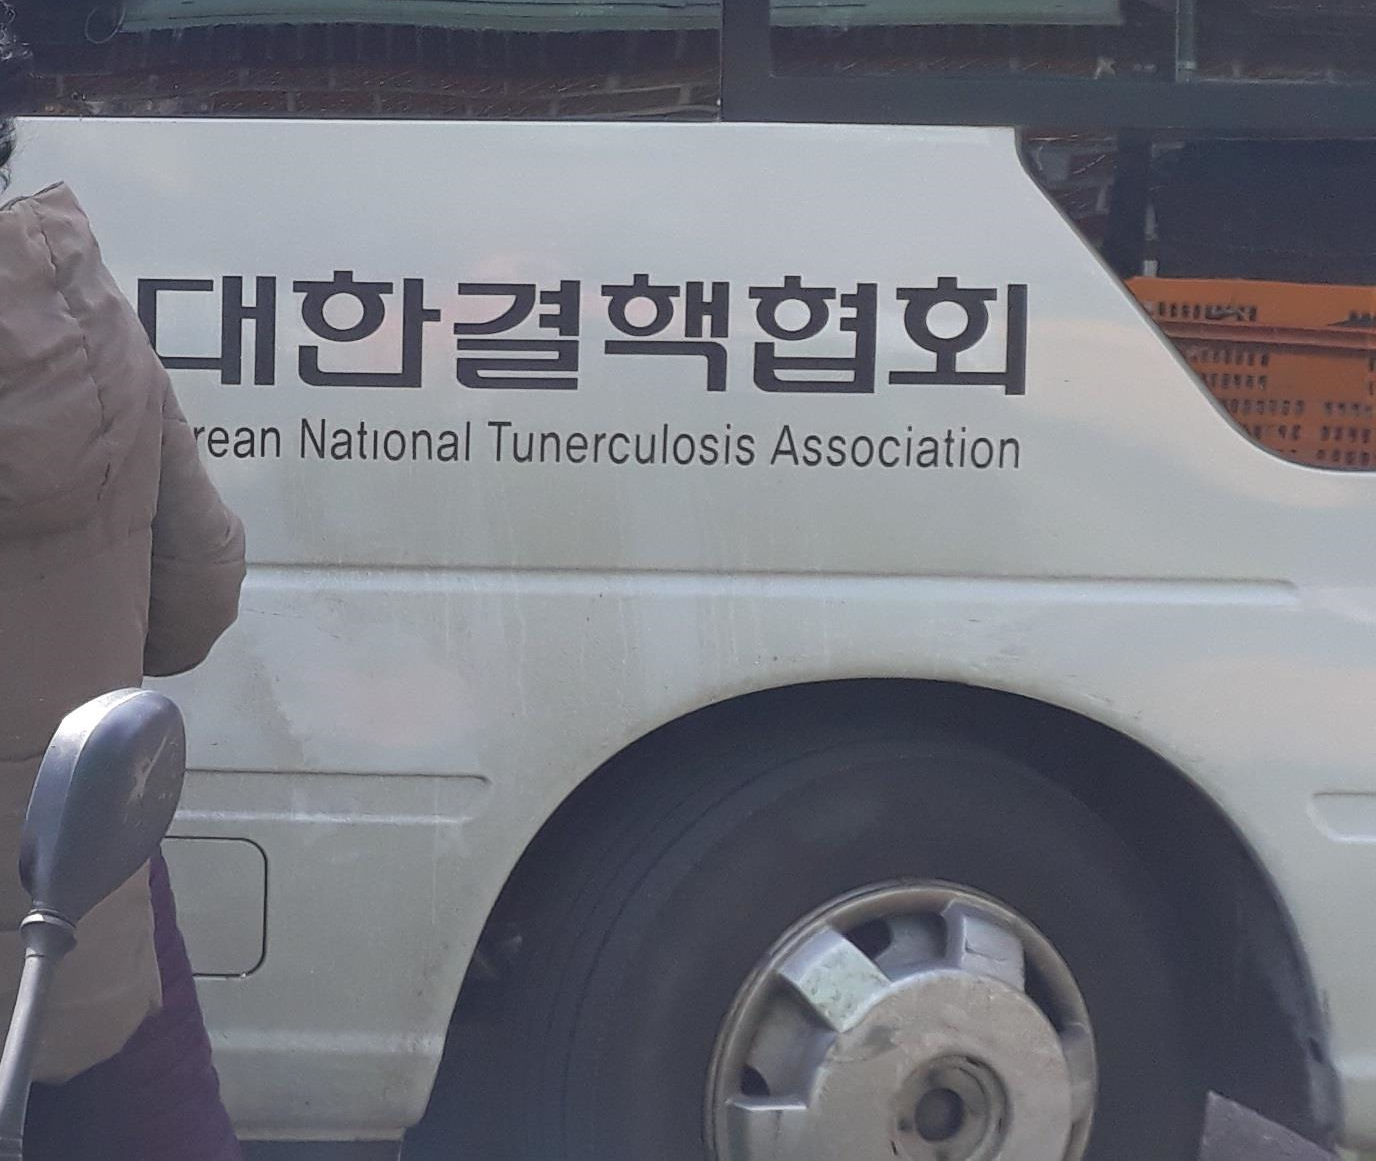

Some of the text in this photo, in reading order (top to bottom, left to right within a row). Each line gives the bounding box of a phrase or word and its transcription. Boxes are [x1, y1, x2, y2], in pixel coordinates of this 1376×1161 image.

[137, 270, 1028, 396] 대한결핵협회
[193, 418, 1022, 469] rean National Tunerculosis Association
